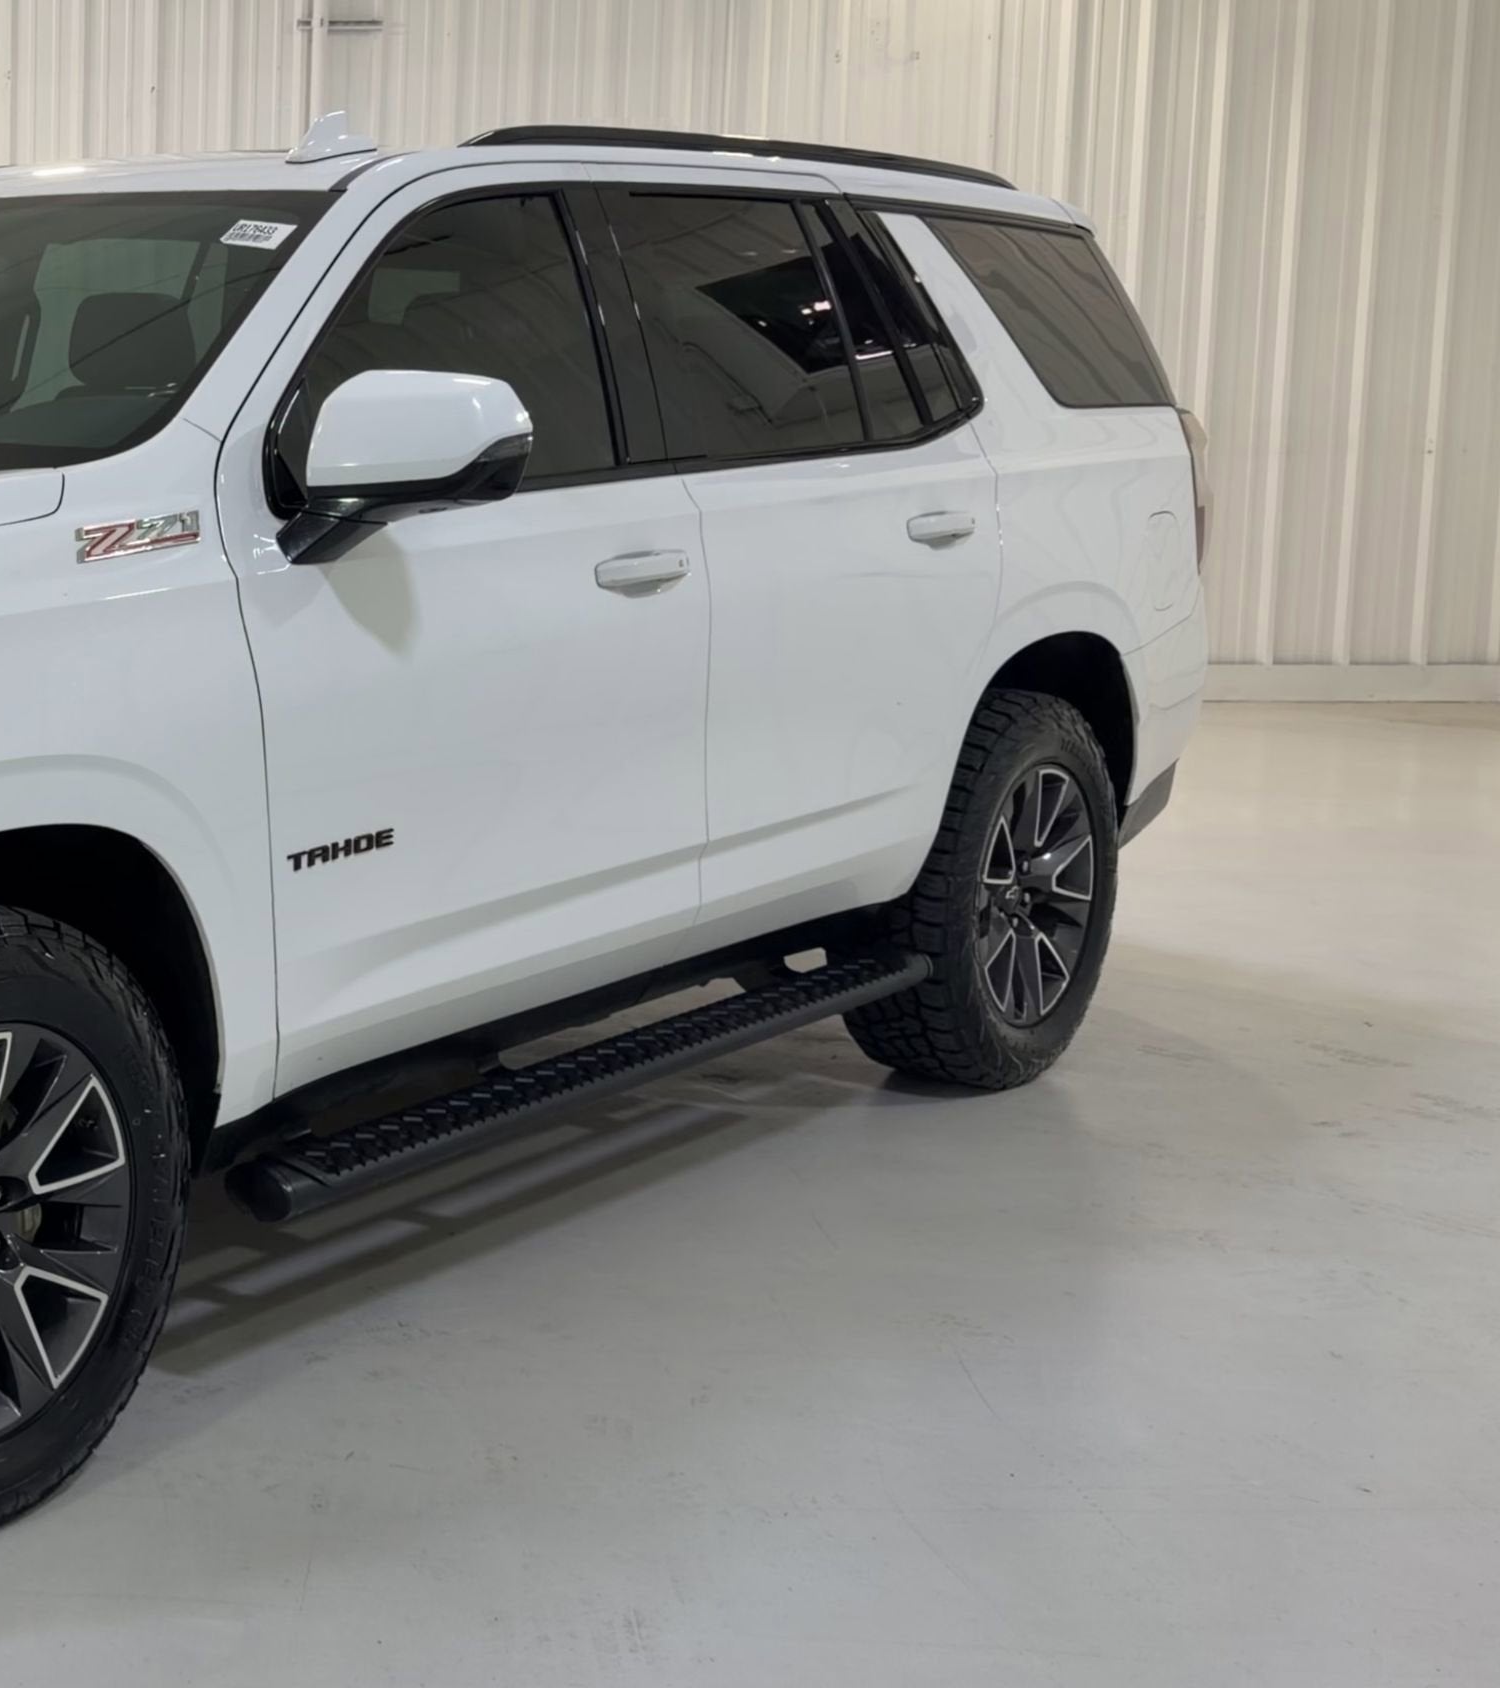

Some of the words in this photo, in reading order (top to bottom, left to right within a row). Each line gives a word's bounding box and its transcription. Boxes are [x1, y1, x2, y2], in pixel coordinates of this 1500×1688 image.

[232, 223, 279, 235] UR176433
[75, 510, 200, 564] Z71
[286, 827, 395, 873] TAHOE
